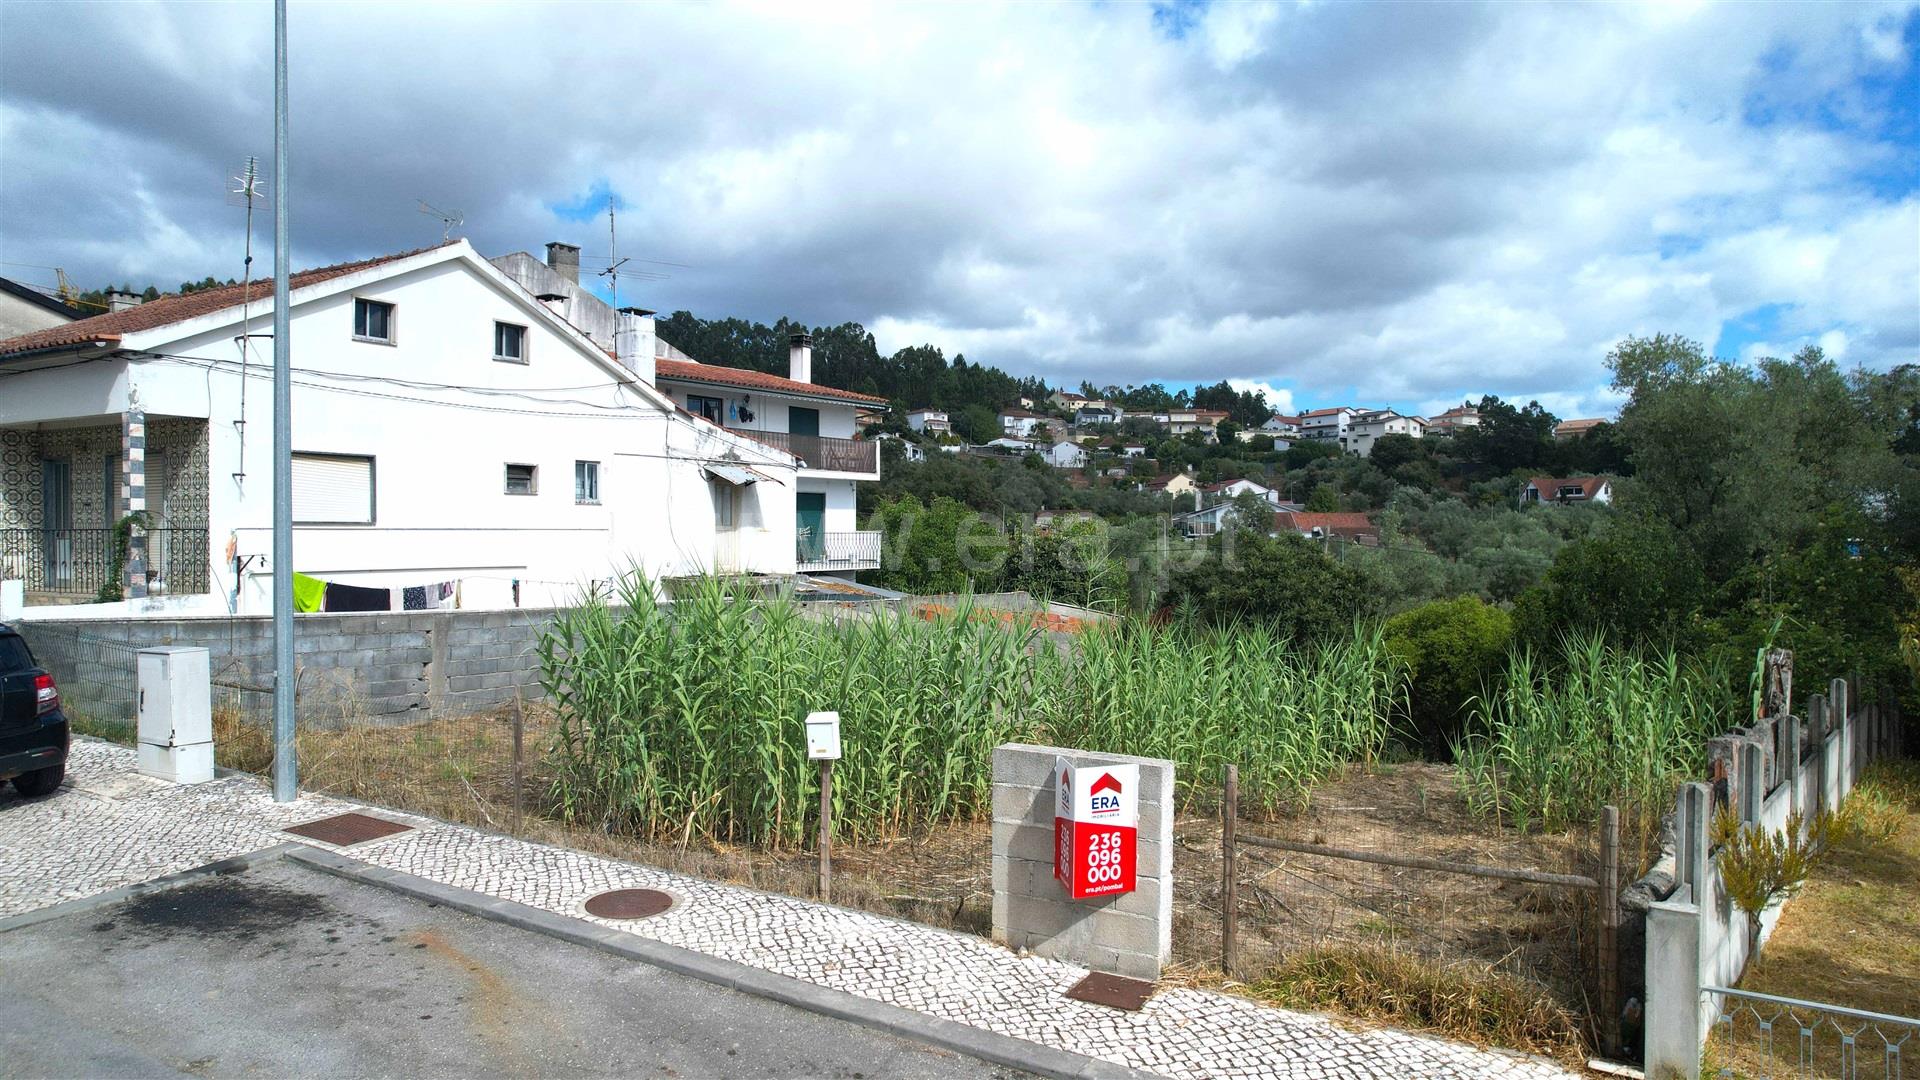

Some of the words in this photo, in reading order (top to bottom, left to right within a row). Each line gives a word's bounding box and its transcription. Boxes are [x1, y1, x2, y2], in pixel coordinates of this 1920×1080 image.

[1091, 796, 1120, 810] ERA
[1089, 831, 1121, 851] 236
[1088, 848, 1121, 867] 096
[1087, 864, 1121, 883] 000
[1085, 882, 1123, 894] era.pt/pombal
